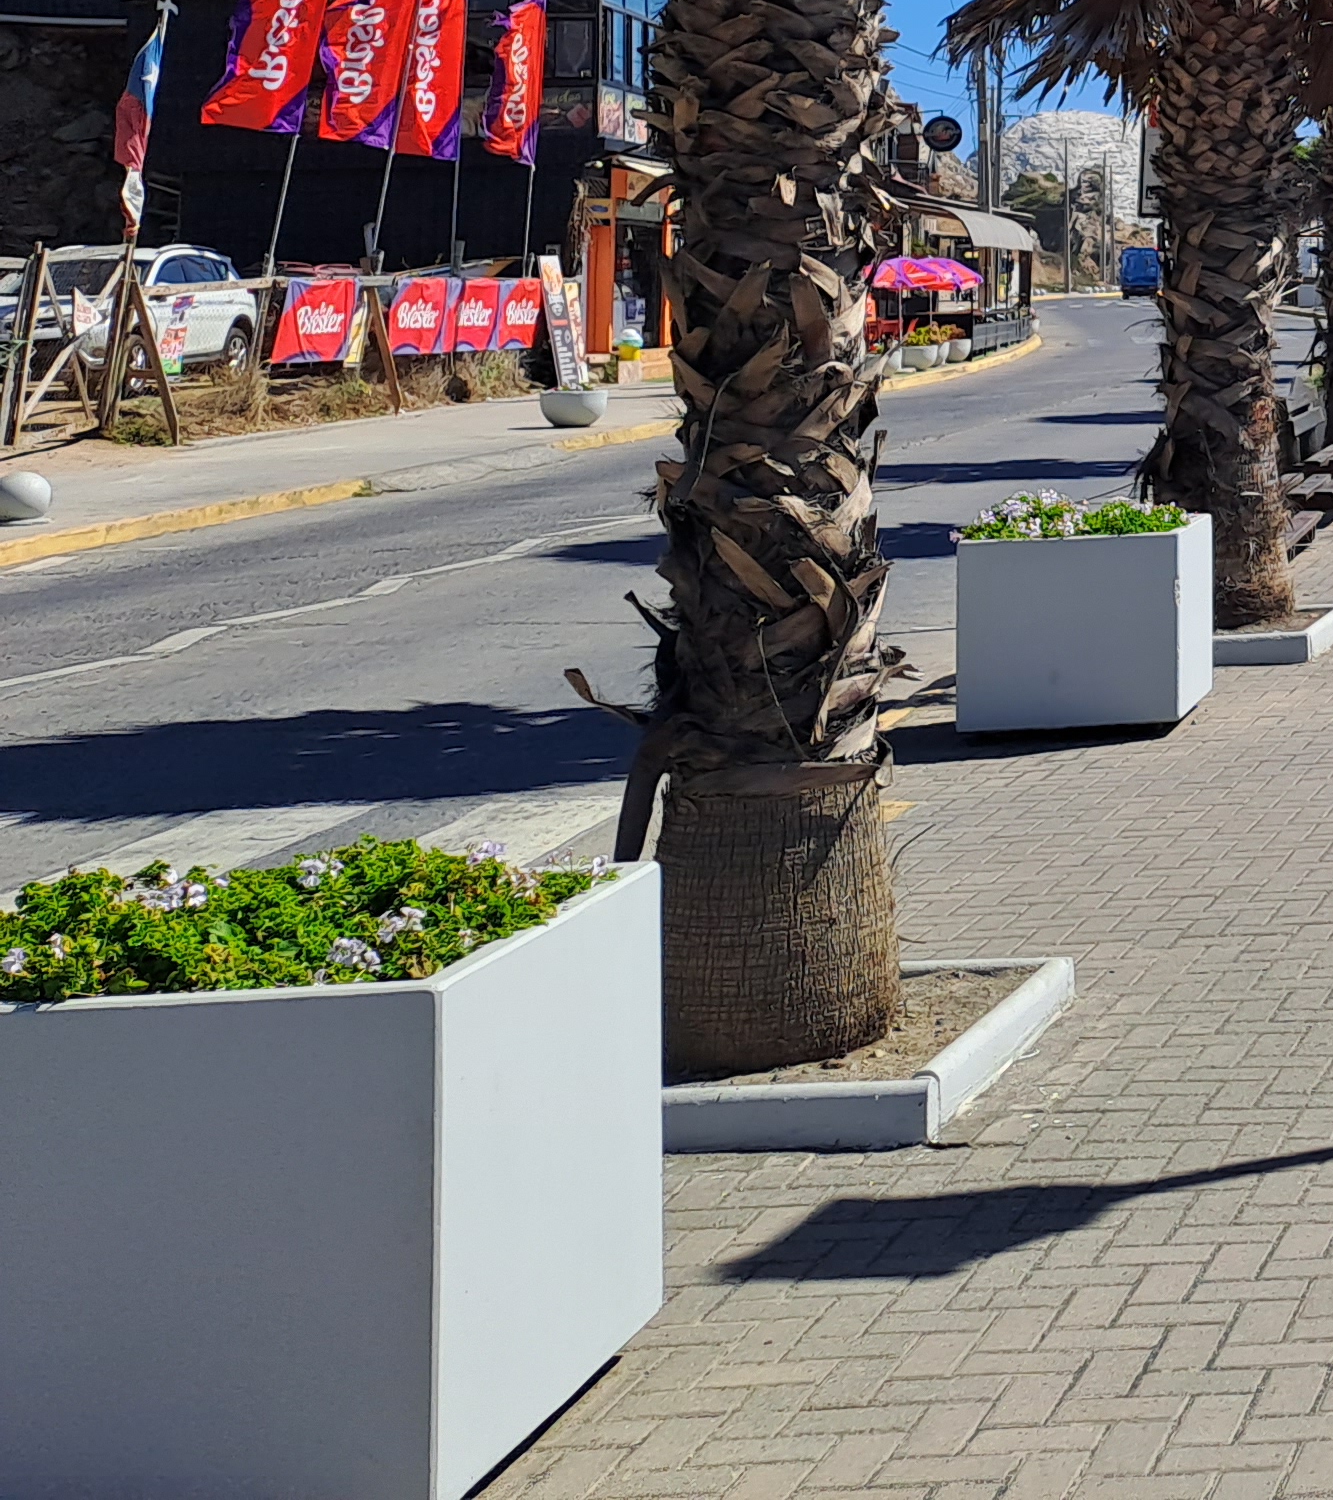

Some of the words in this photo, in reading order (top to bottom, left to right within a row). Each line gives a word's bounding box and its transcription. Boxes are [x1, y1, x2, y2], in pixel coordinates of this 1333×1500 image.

[296, 301, 345, 334] Bresler
[397, 298, 439, 328] Bresler
[457, 297, 493, 326] resler
